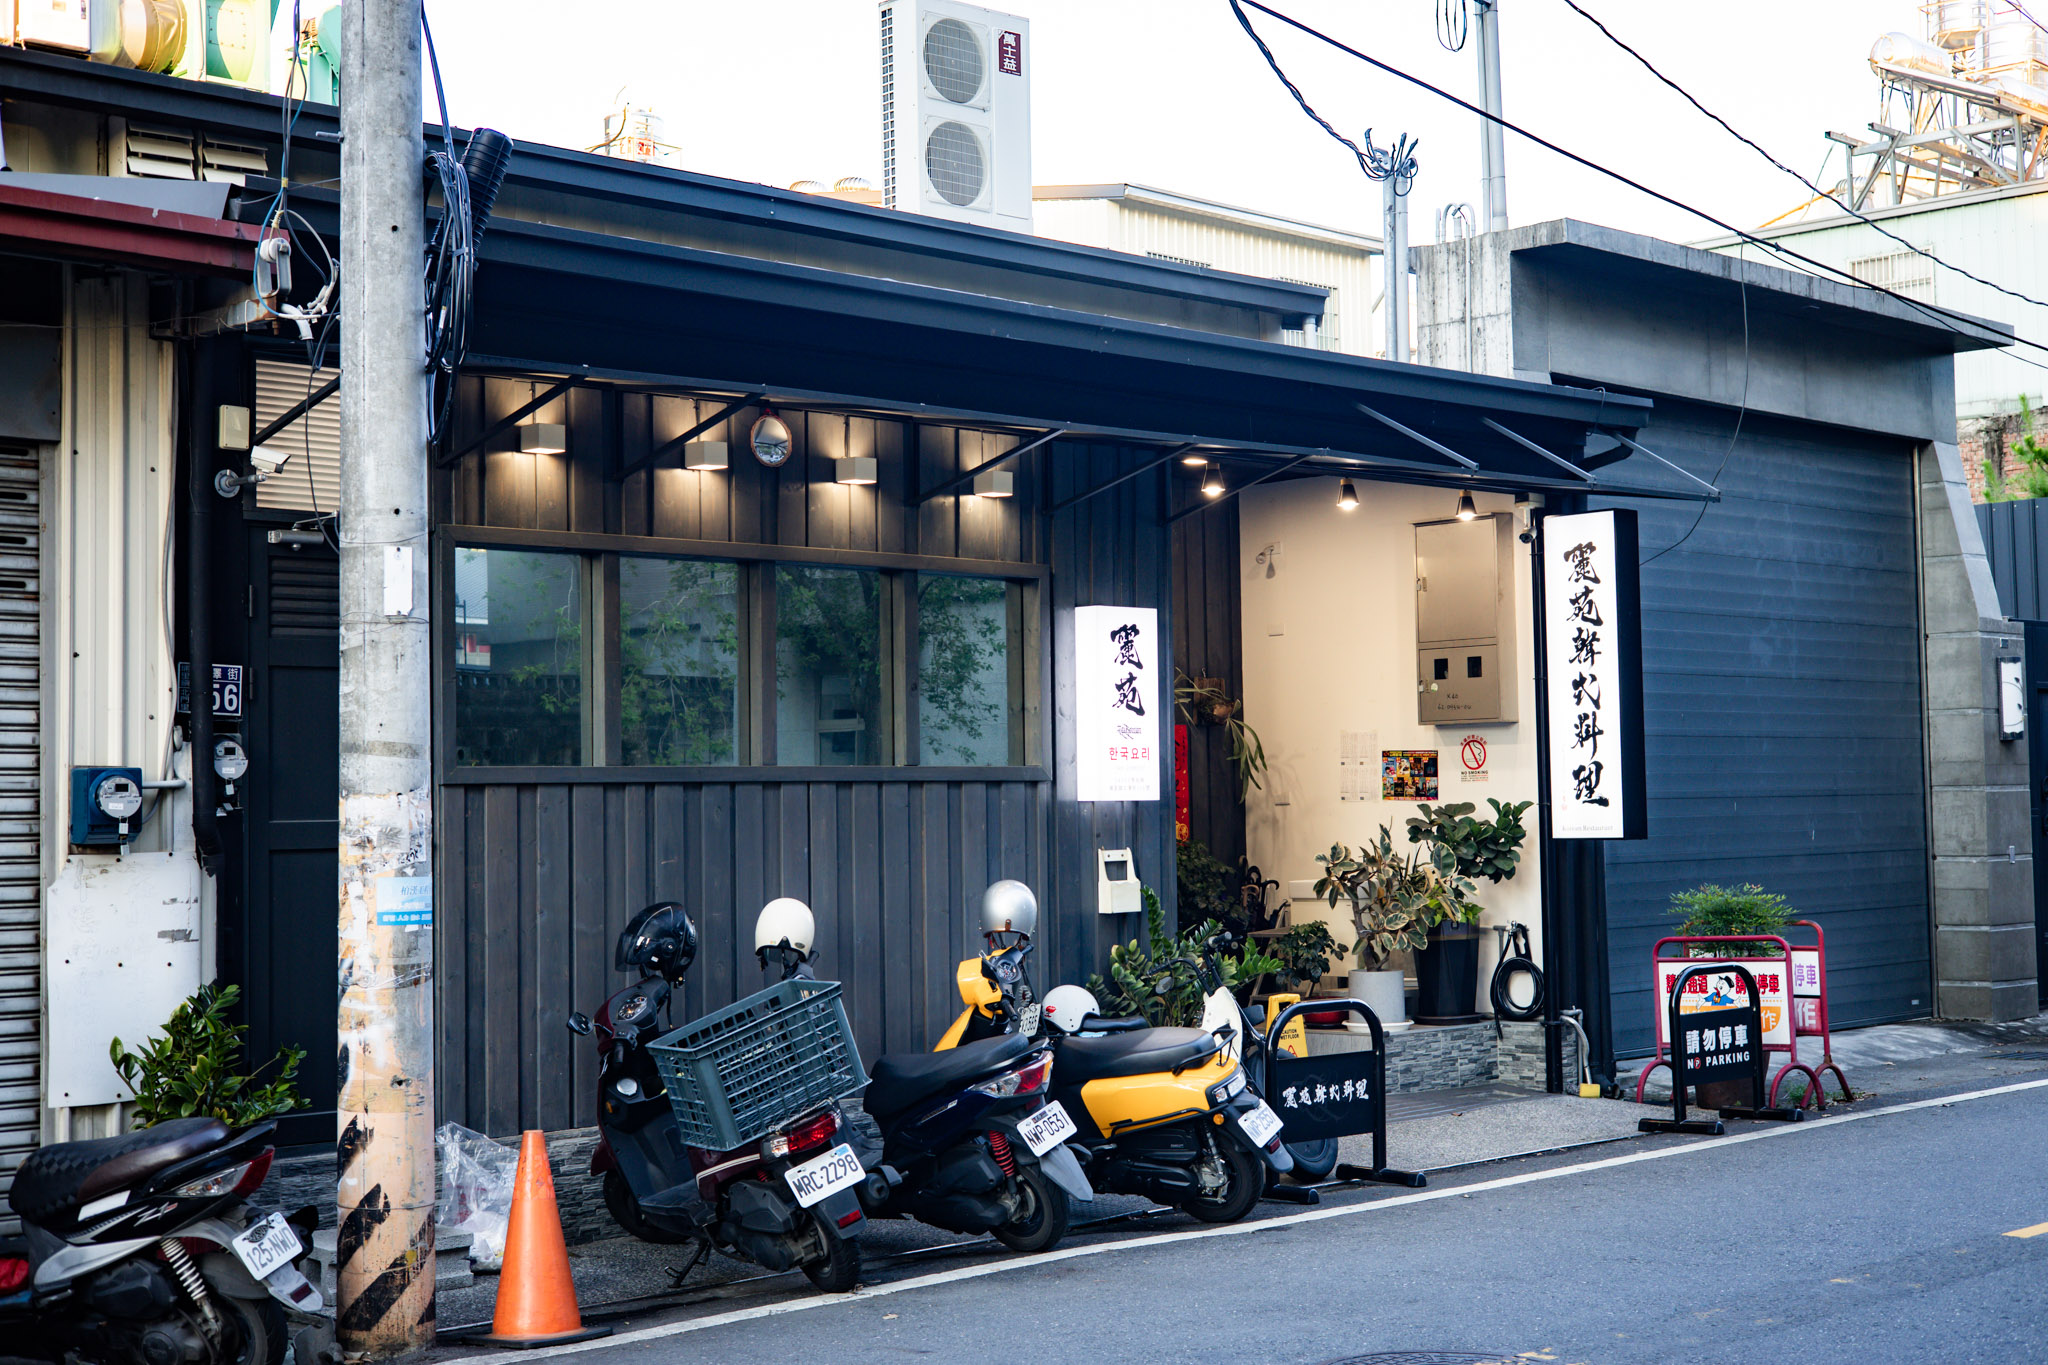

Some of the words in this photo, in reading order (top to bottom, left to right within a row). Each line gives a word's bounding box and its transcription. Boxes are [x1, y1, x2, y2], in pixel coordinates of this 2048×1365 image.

[1003, 32, 1017, 71] 萬士益
[1110, 624, 1146, 717] 麗苑
[1563, 541, 1609, 807] 麗苑韓式料理
[1109, 746, 1150, 761] 한국요리
[1686, 1024, 1749, 1054] 請勿停車
[1706, 1051, 1750, 1067] PARKING
[1024, 1110, 1070, 1148] NWP-0531
[792, 1154, 859, 1199] MRC-2298
